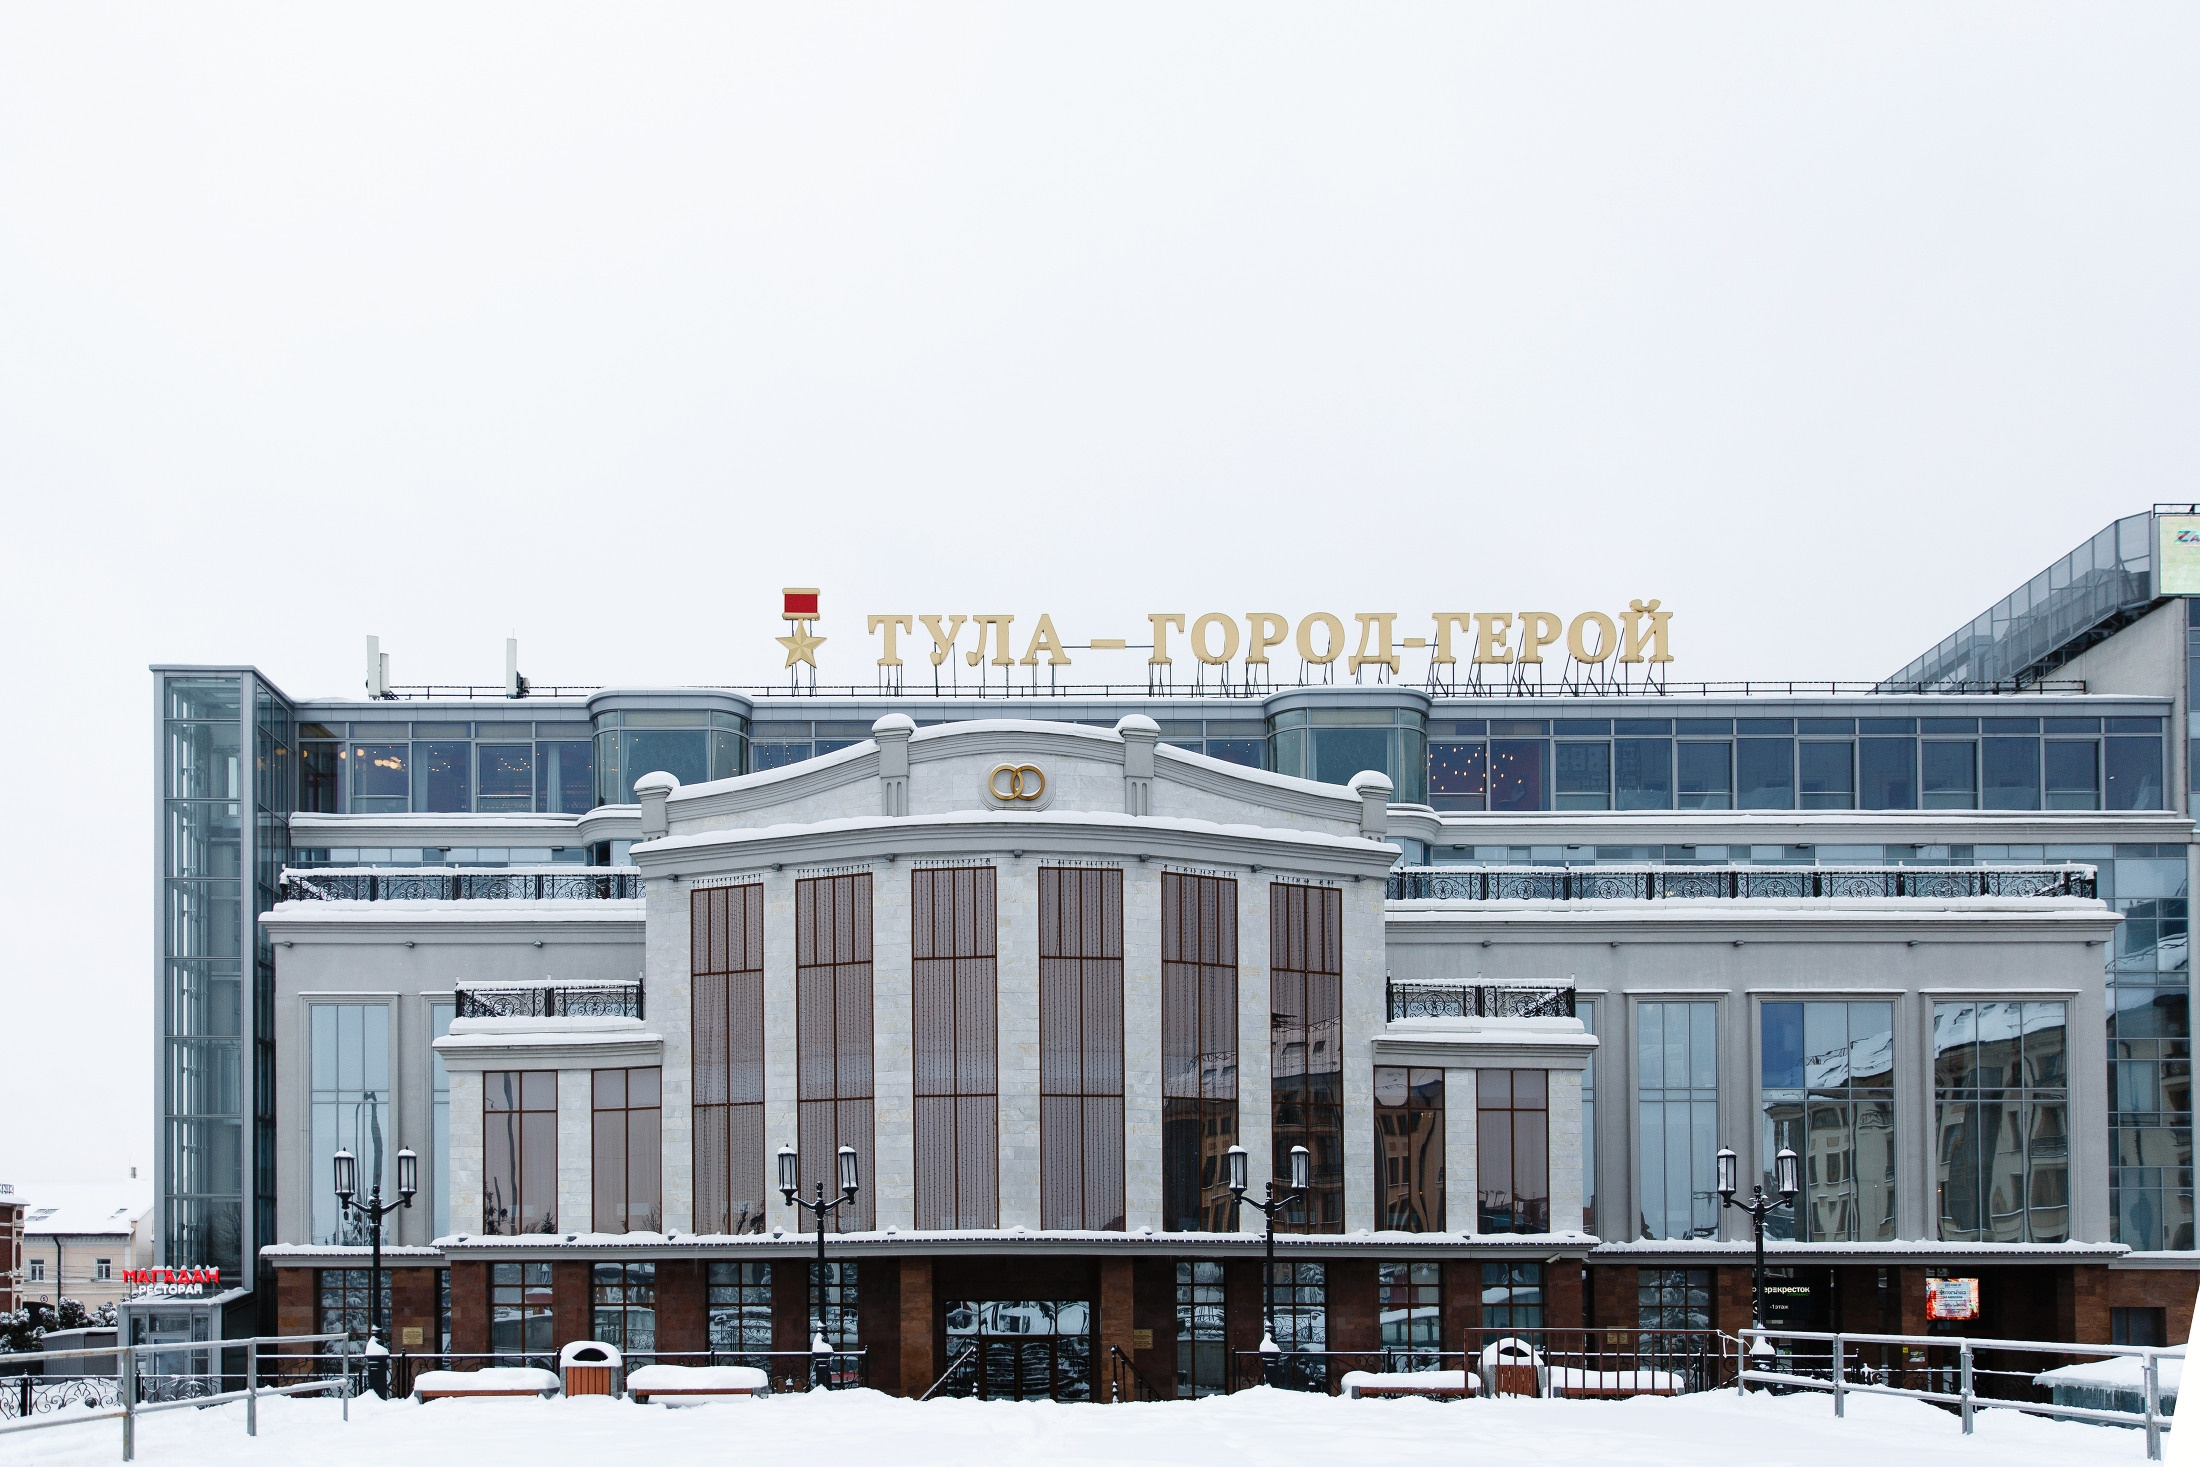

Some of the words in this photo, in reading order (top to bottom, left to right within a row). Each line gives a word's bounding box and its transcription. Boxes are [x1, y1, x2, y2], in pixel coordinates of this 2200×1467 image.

[867, 613, 1072, 666] ТУЛА
[122, 1268, 220, 1284] МАГАДАН
[138, 1283, 203, 1295] РЕСТОРАН
